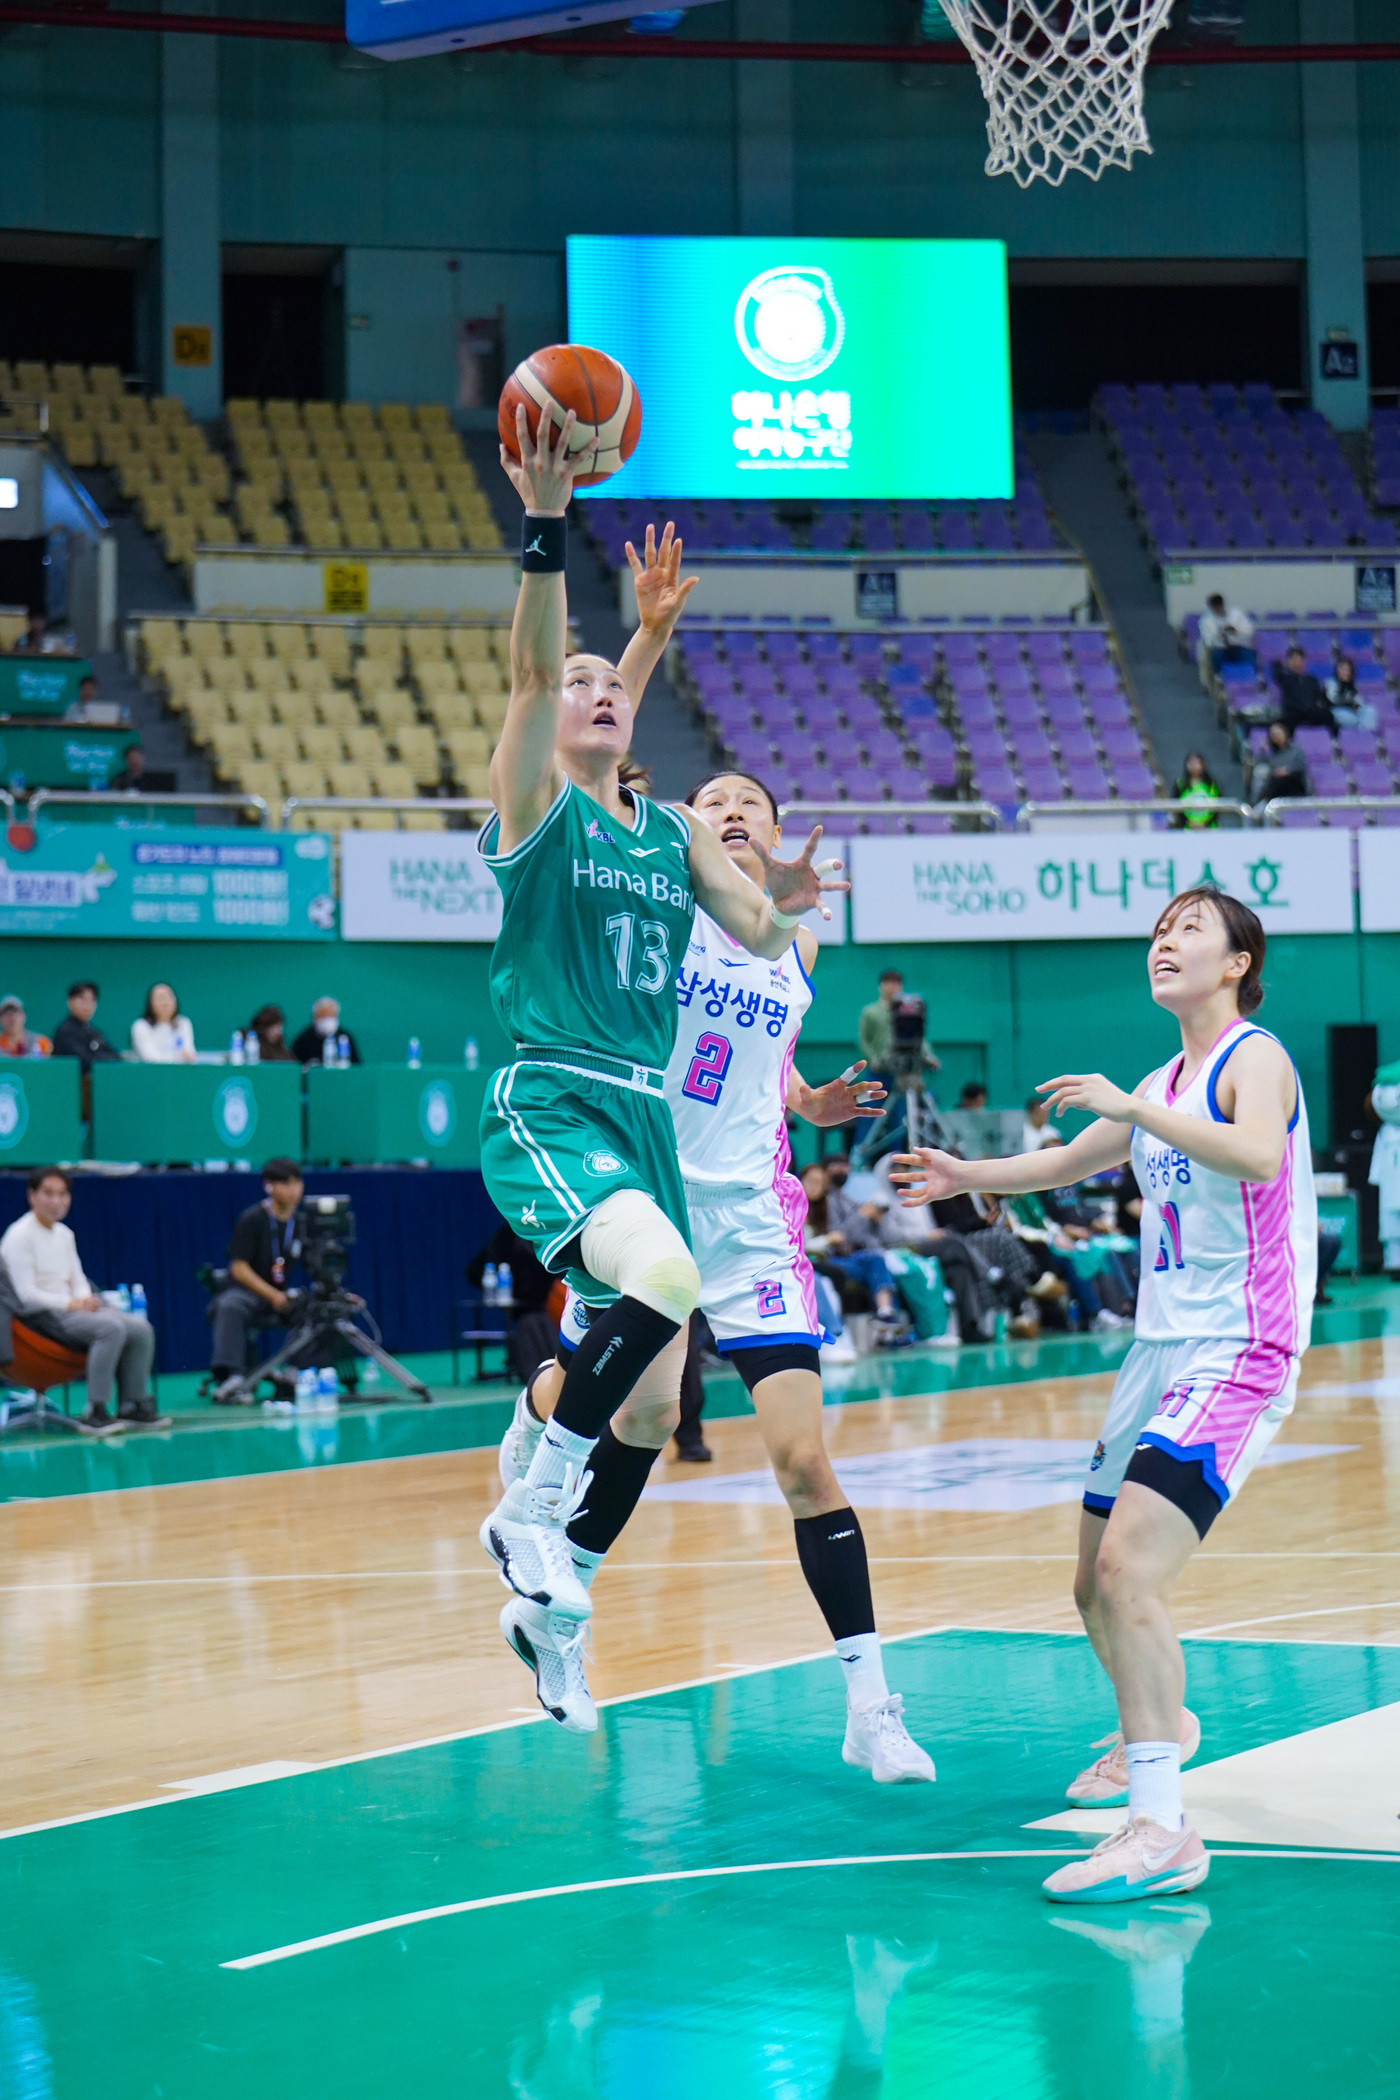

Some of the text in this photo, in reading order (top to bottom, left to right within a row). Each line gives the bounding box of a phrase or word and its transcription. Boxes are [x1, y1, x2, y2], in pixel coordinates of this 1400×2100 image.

[390, 857, 472, 884] HANA
[573, 858, 647, 897] Hana
[913, 861, 994, 887] HANA
[420, 886, 497, 914] NEXT
[916, 888, 1026, 916] THE SOHO
[605, 911, 672, 995] 13
[676, 966, 789, 1038] 삼성생명
[681, 1030, 734, 1107] 2
[1145, 1147, 1192, 1189] 성생명
[753, 1279, 787, 1319] 2
